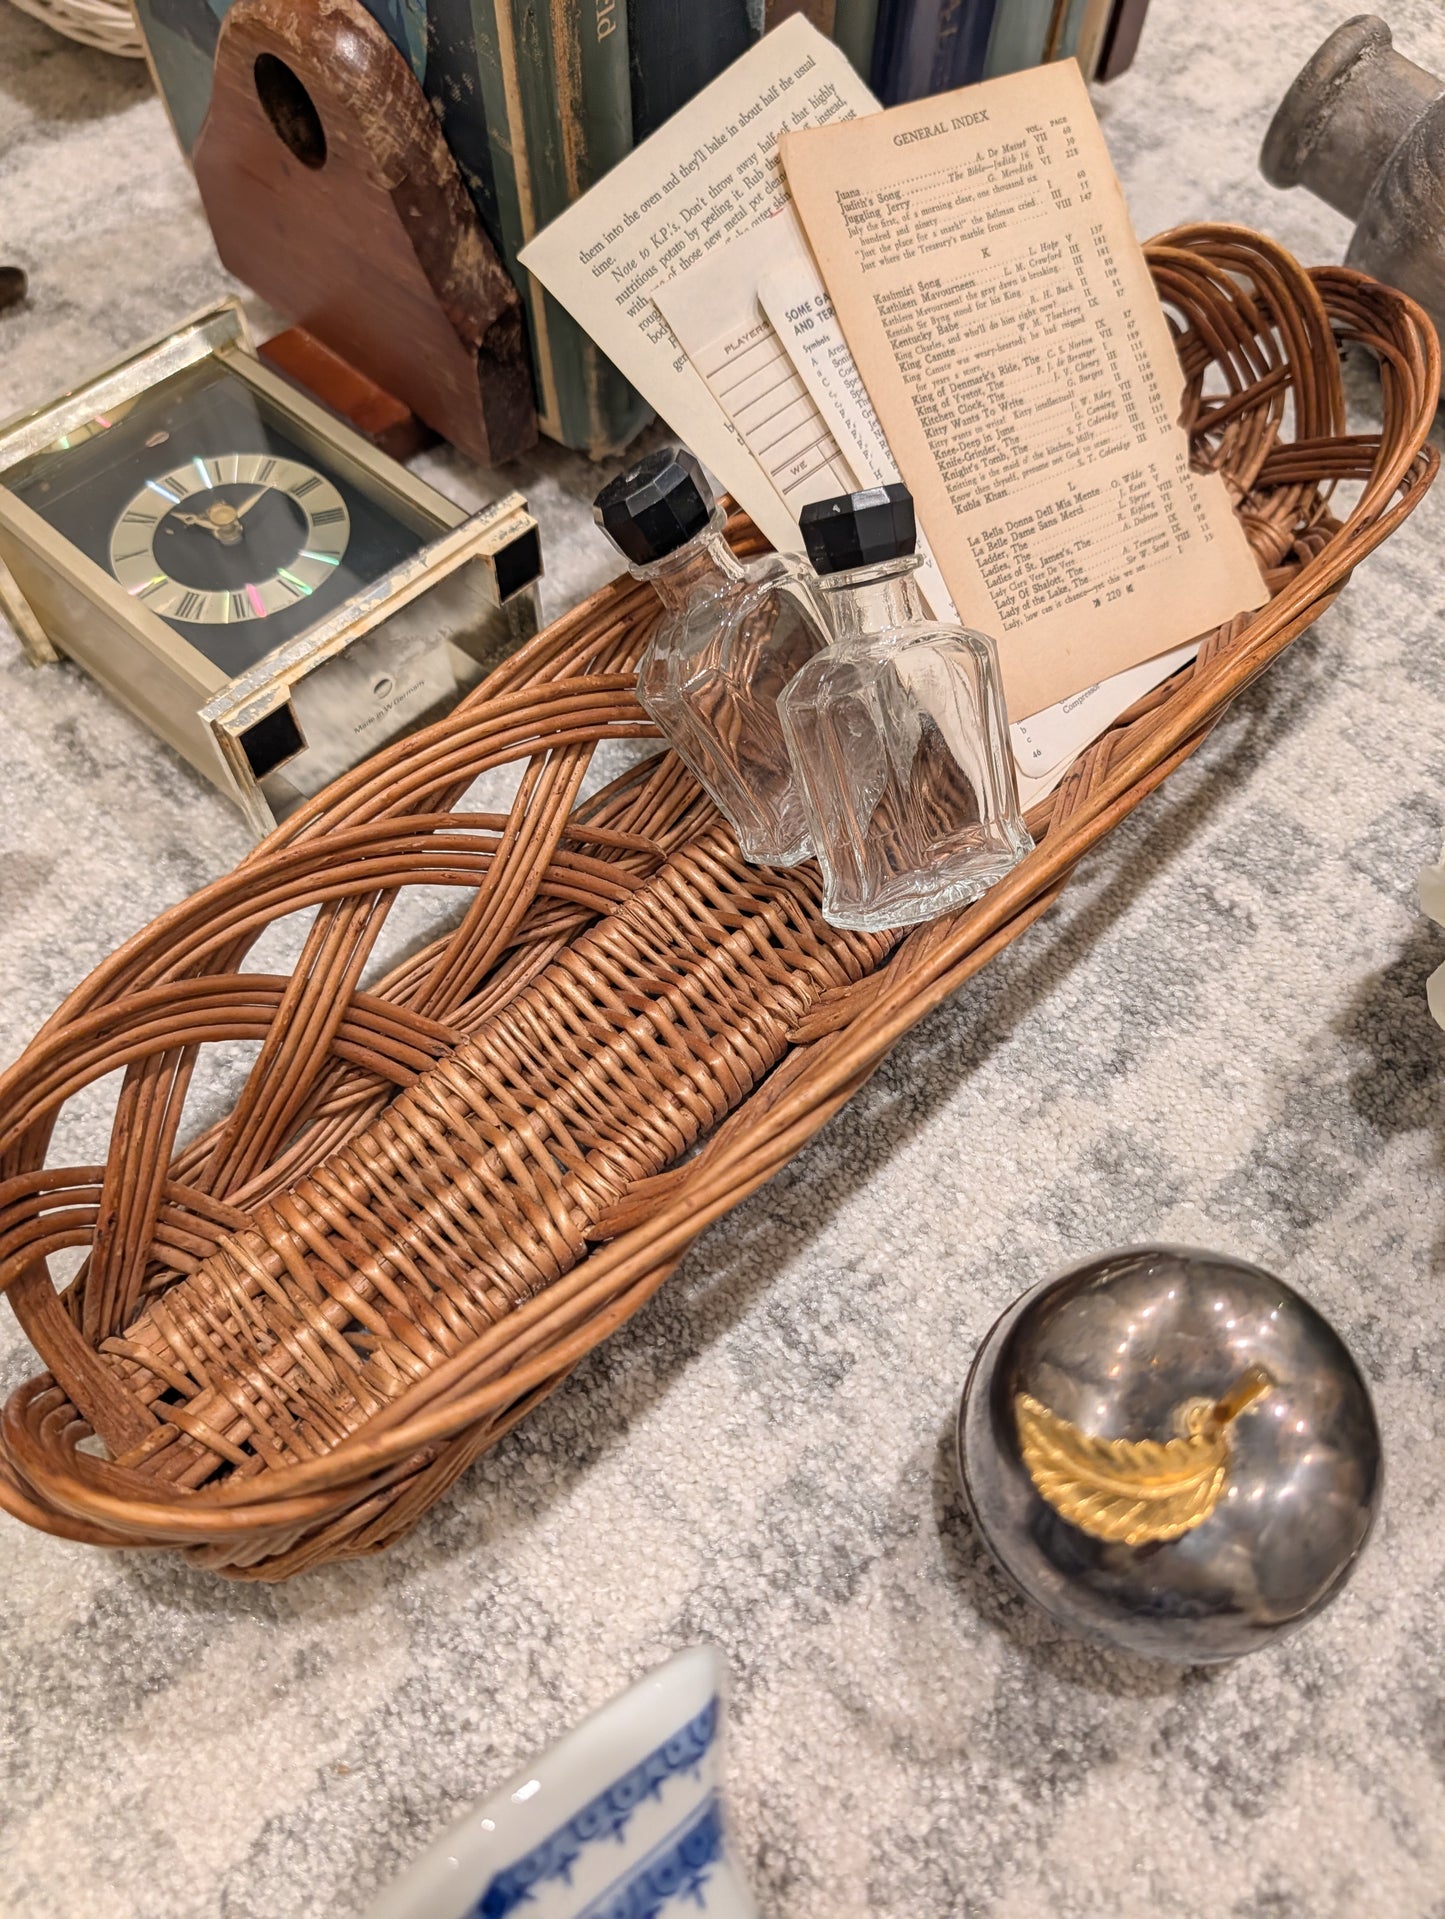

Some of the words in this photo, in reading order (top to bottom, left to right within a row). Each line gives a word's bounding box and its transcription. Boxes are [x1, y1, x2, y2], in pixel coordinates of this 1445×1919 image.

[596, 0, 617, 44] ld
[893, 122, 948, 146] GENERAL
[950, 109, 989, 130] INDEX
[1049, 116, 1067, 127] PAGE
[579, 242, 605, 264] them
[602, 224, 624, 244] into
[623, 210, 640, 227] the
[640, 192, 662, 212] oven
[662, 172, 680, 193] and
[679, 149, 707, 178] they'll
[703, 134, 728, 154] bake
[725, 125, 738, 137] in
[738, 103, 763, 127] about
[759, 85, 779, 106] half
[779, 76, 794, 91] the
[793, 54, 816, 79] usual
[610, 259, 637, 283] Note
[679, 197, 707, 223] Don't
[708, 174, 733, 199] throw
[736, 152, 758, 175] away
[756, 132, 778, 154] half
[780, 120, 790, 136] of
[791, 107, 809, 125] that
[807, 83, 837, 109] highly
[769, 188, 792, 210] skin
[835, 189, 860, 203] Juana
[615, 265, 658, 305] nutritious
[658, 240, 686, 268] potato
[683, 227, 700, 241] by
[700, 199, 734, 232] peeling
[742, 169, 764, 190] Rub
[814, 95, 847, 128] instead,
[839, 197, 873, 215] Judith's
[876, 190, 901, 203] Song
[843, 208, 882, 227] Juggling
[885, 200, 910, 215] Jerry
[847, 225, 863, 239] July
[917, 236, 957, 254] Treasury's
[591, 256, 616, 277] time.
[626, 296, 649, 317] with
[679, 248, 703, 270] those
[703, 229, 721, 250] new
[723, 205, 748, 232] metal
[748, 192, 764, 212] pot
[785, 301, 812, 322] SOME
[812, 290, 832, 308] GA
[872, 284, 914, 305] Kashmiri
[917, 278, 941, 292] Song
[877, 299, 917, 316] Kathleen
[920, 279, 976, 303] Mavourneen
[794, 318, 814, 336] AND
[815, 304, 837, 324] TER
[889, 331, 932, 350] Kentucky
[936, 322, 959, 335] Babe
[723, 321, 771, 355] PLAYERS
[802, 335, 830, 353] Symbols
[898, 359, 922, 372] King
[924, 348, 955, 364] Canute
[911, 393, 934, 406] King
[948, 370, 995, 393] Denmark's
[997, 362, 1020, 376] Ride,
[1021, 355, 1040, 367] The
[915, 403, 939, 416] King
[985, 380, 1004, 391] The
[919, 411, 955, 428] Kitchen
[986, 392, 1005, 404] The
[923, 425, 947, 439] Kitty
[950, 413, 980, 429] Wants
[981, 407, 995, 418] To
[998, 398, 1024, 412] Write
[932, 438, 981, 460] Knee-Deep
[995, 425, 1015, 440] June
[1001, 436, 1019, 447] The
[790, 460, 807, 475] WE
[941, 462, 979, 482] Knight's
[1009, 445, 1028, 456] The
[954, 499, 981, 515] Kubla
[983, 489, 1007, 503] Khan
[966, 536, 980, 547] La
[981, 526, 1004, 541] Bella
[1004, 515, 1034, 531] Donna
[1035, 504, 1053, 519] Dell
[1055, 498, 1072, 511] Mia
[1073, 488, 1100, 504] Mente
[986, 537, 1008, 551] Belle
[1010, 527, 1035, 542] Dame
[1037, 518, 1058, 530] Sans
[1059, 504, 1084, 521] Merci
[975, 551, 1008, 568] Ladder,
[1009, 542, 1028, 553] The
[980, 562, 1011, 578] Ladies,
[1012, 553, 1031, 564] The
[984, 573, 1012, 589] Ladies
[1073, 539, 1091, 551] The
[993, 595, 1015, 610] Lady
[1065, 567, 1083, 578] The
[998, 606, 1019, 620] Lady
[1031, 595, 1045, 606] the
[1071, 576, 1088, 588] The
[1105, 588, 1121, 601] 220
